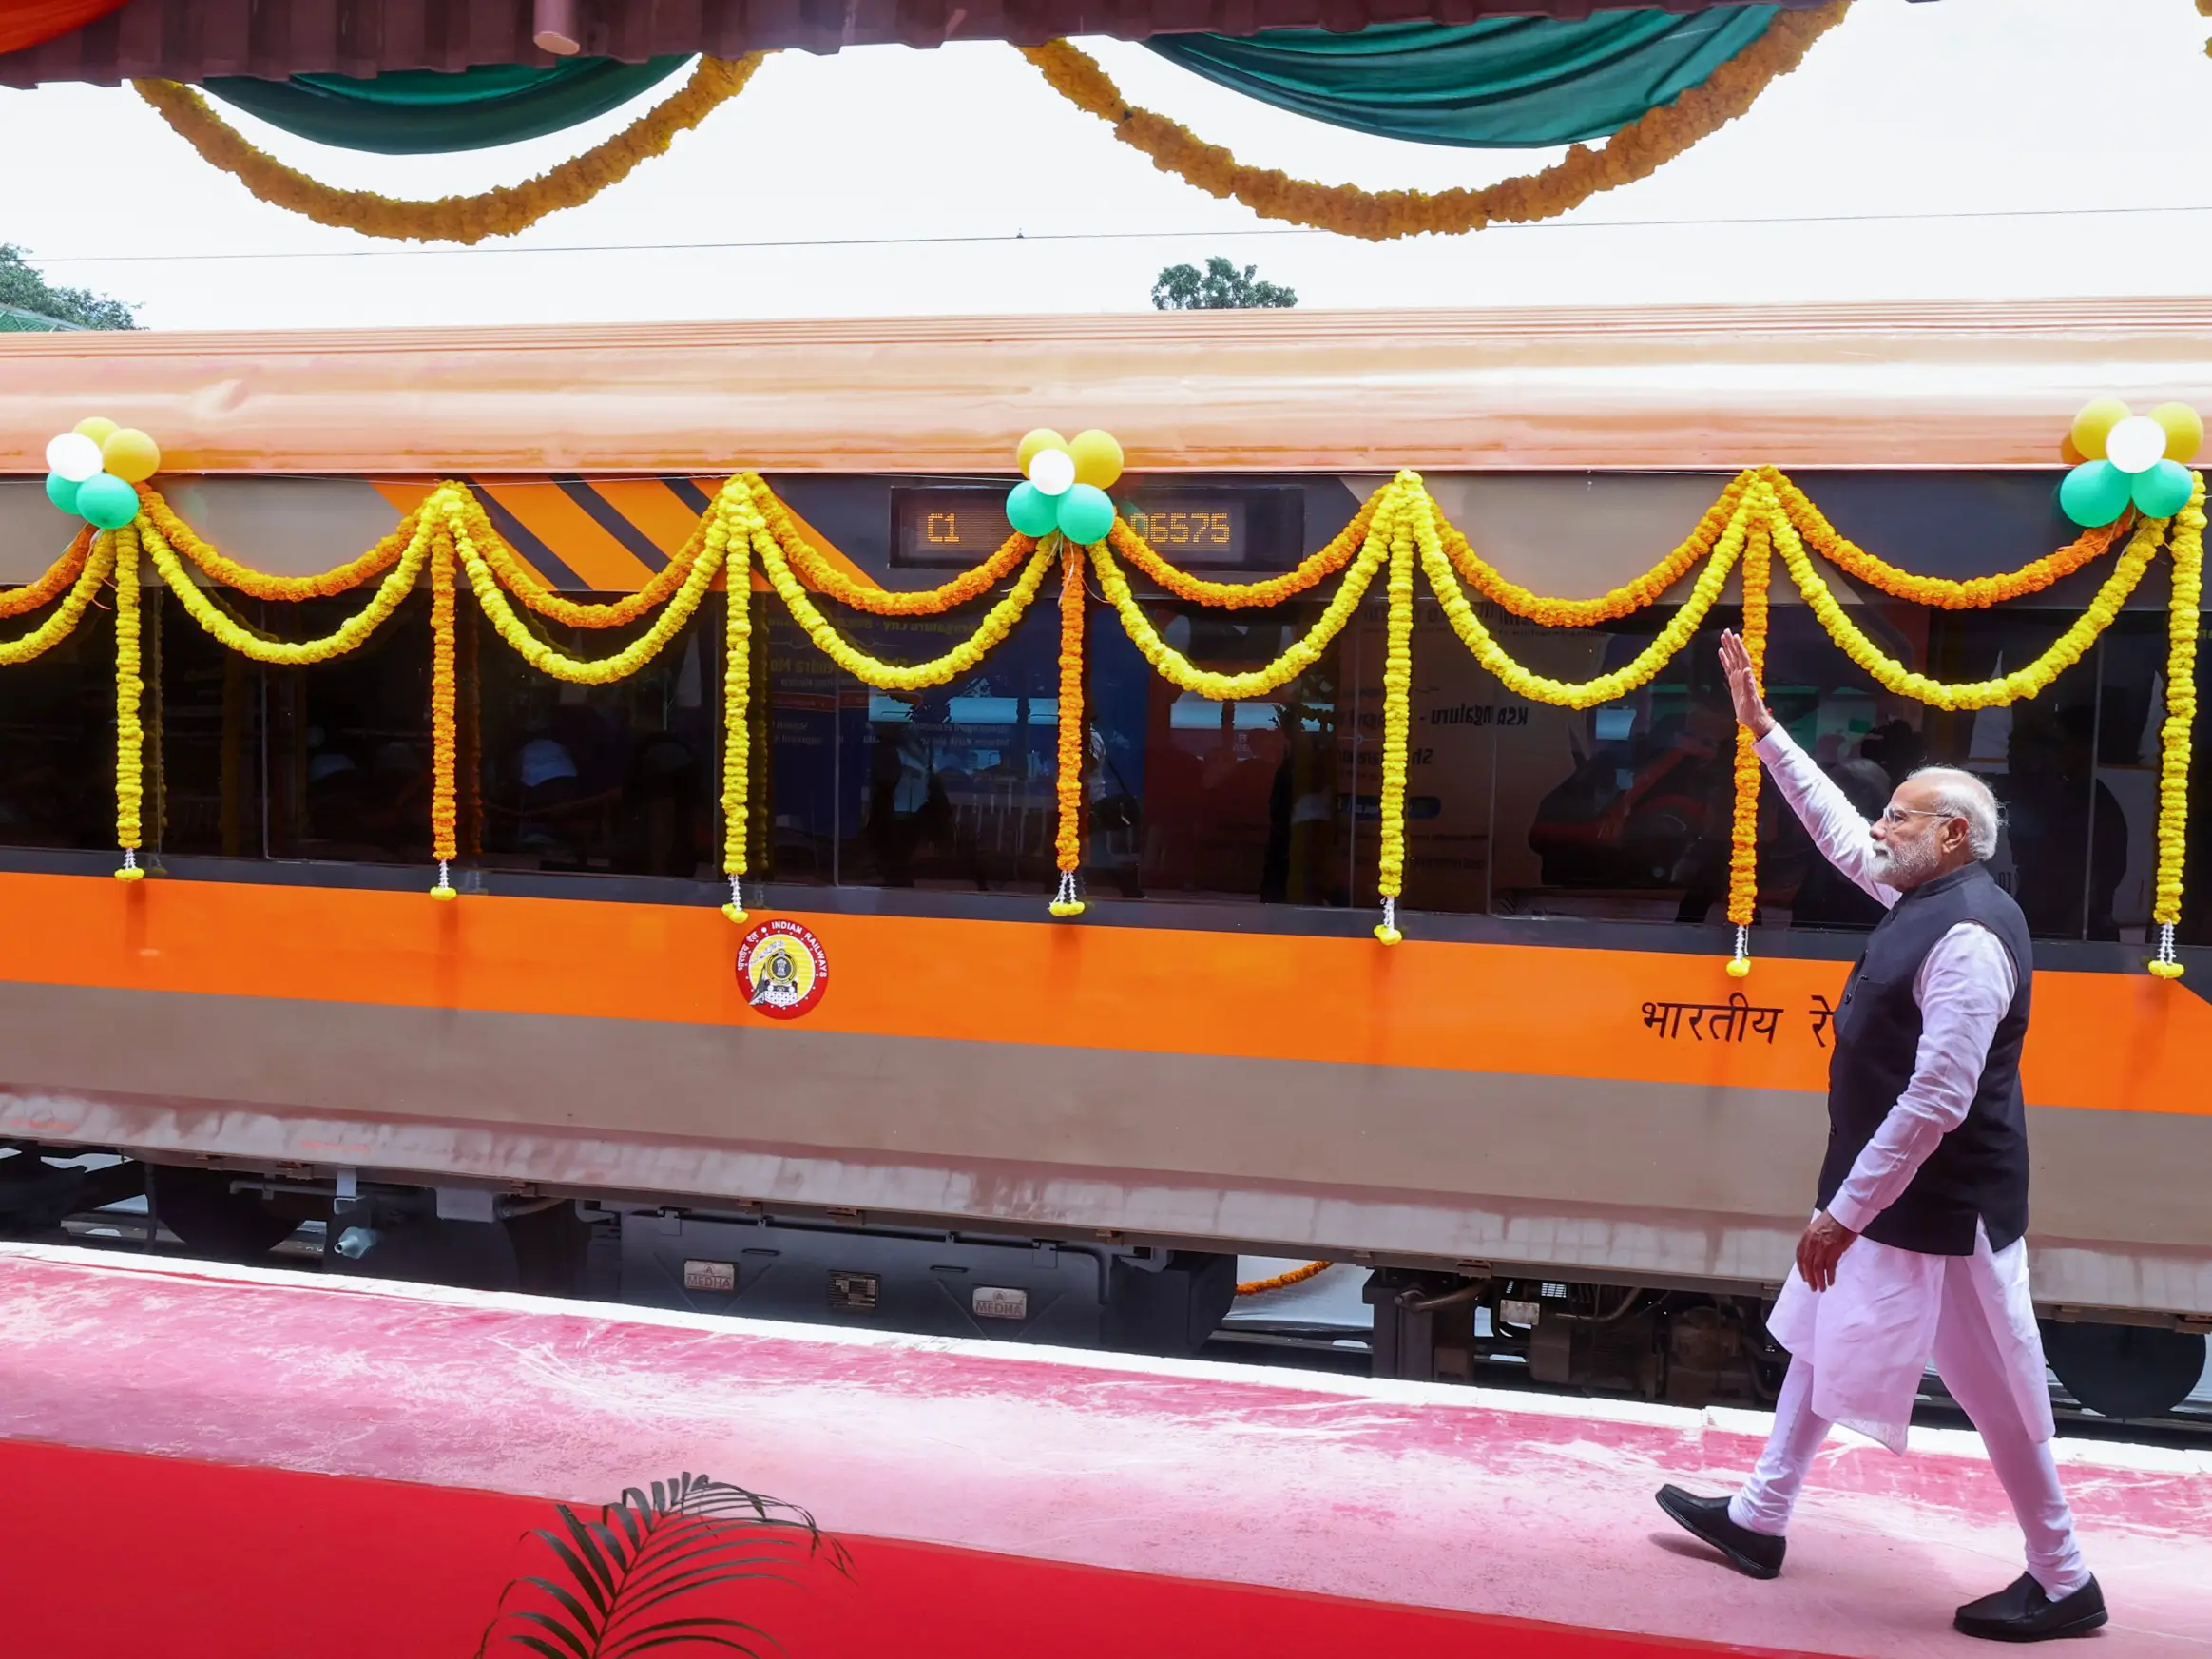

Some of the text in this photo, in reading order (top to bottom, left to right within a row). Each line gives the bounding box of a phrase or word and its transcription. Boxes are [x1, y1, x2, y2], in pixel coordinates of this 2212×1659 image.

[927, 512, 960, 543] C1
[1130, 512, 1231, 543] 06575
[771, 920, 828, 978] INDIAN RAILWAYS
[1641, 992, 1835, 1048] भारतीय रे
[687, 1275, 732, 1288] MEDHA
[975, 1302, 1024, 1316] MEDHA
